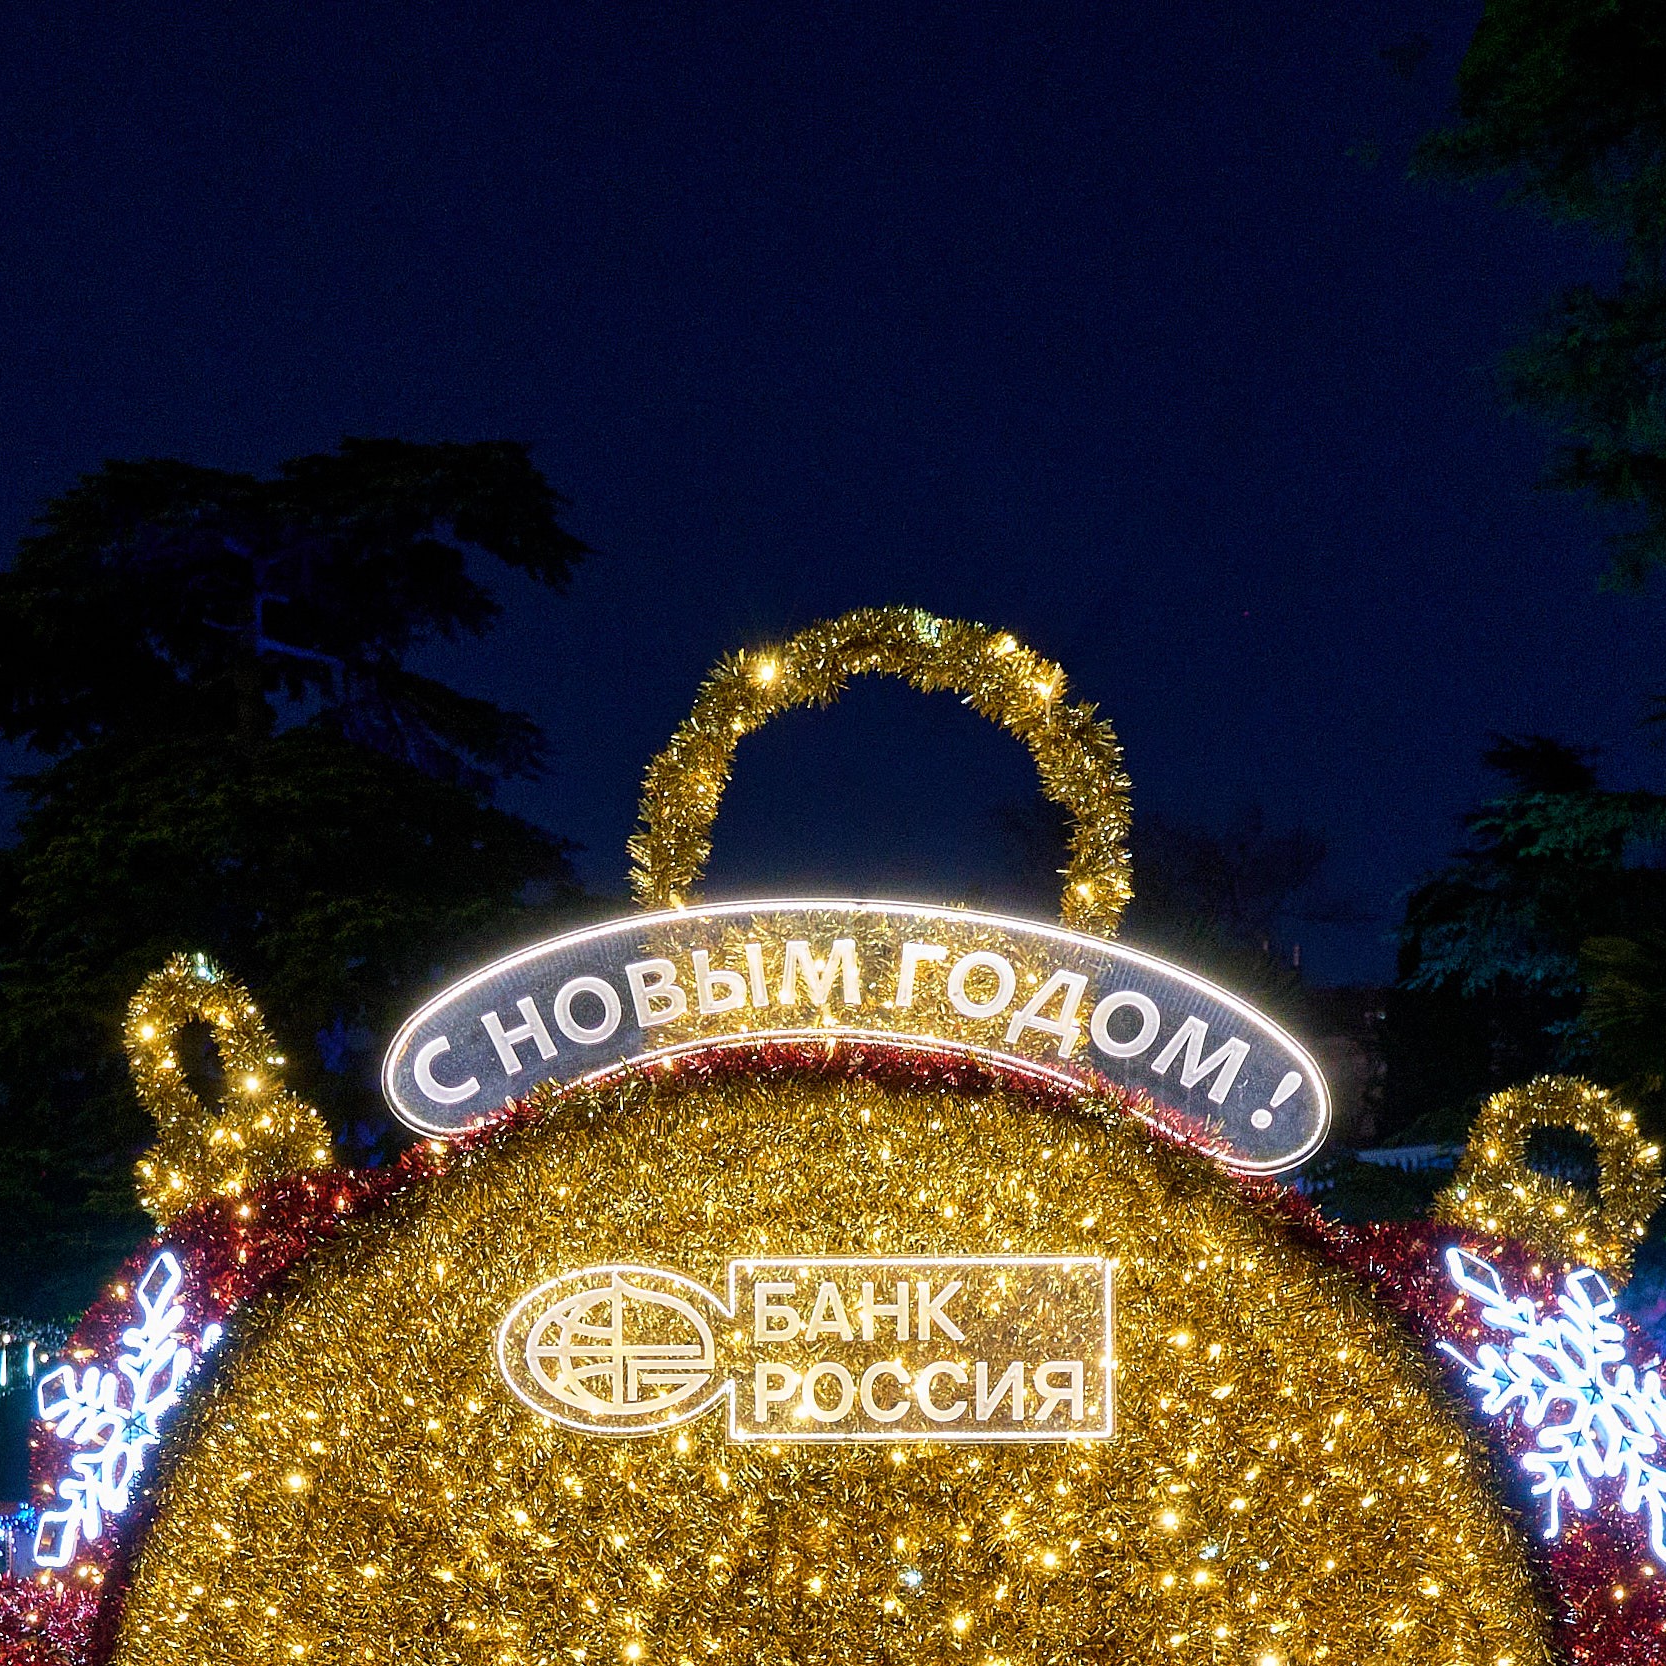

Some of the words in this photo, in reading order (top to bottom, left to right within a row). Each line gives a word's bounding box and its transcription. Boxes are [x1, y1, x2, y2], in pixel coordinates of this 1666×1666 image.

[414, 1036, 480, 1103] С
[480, 938, 862, 1076] НОВЫМ
[754, 1281, 966, 1342] БАНК
[754, 1361, 1084, 1422] РОССИЯ
